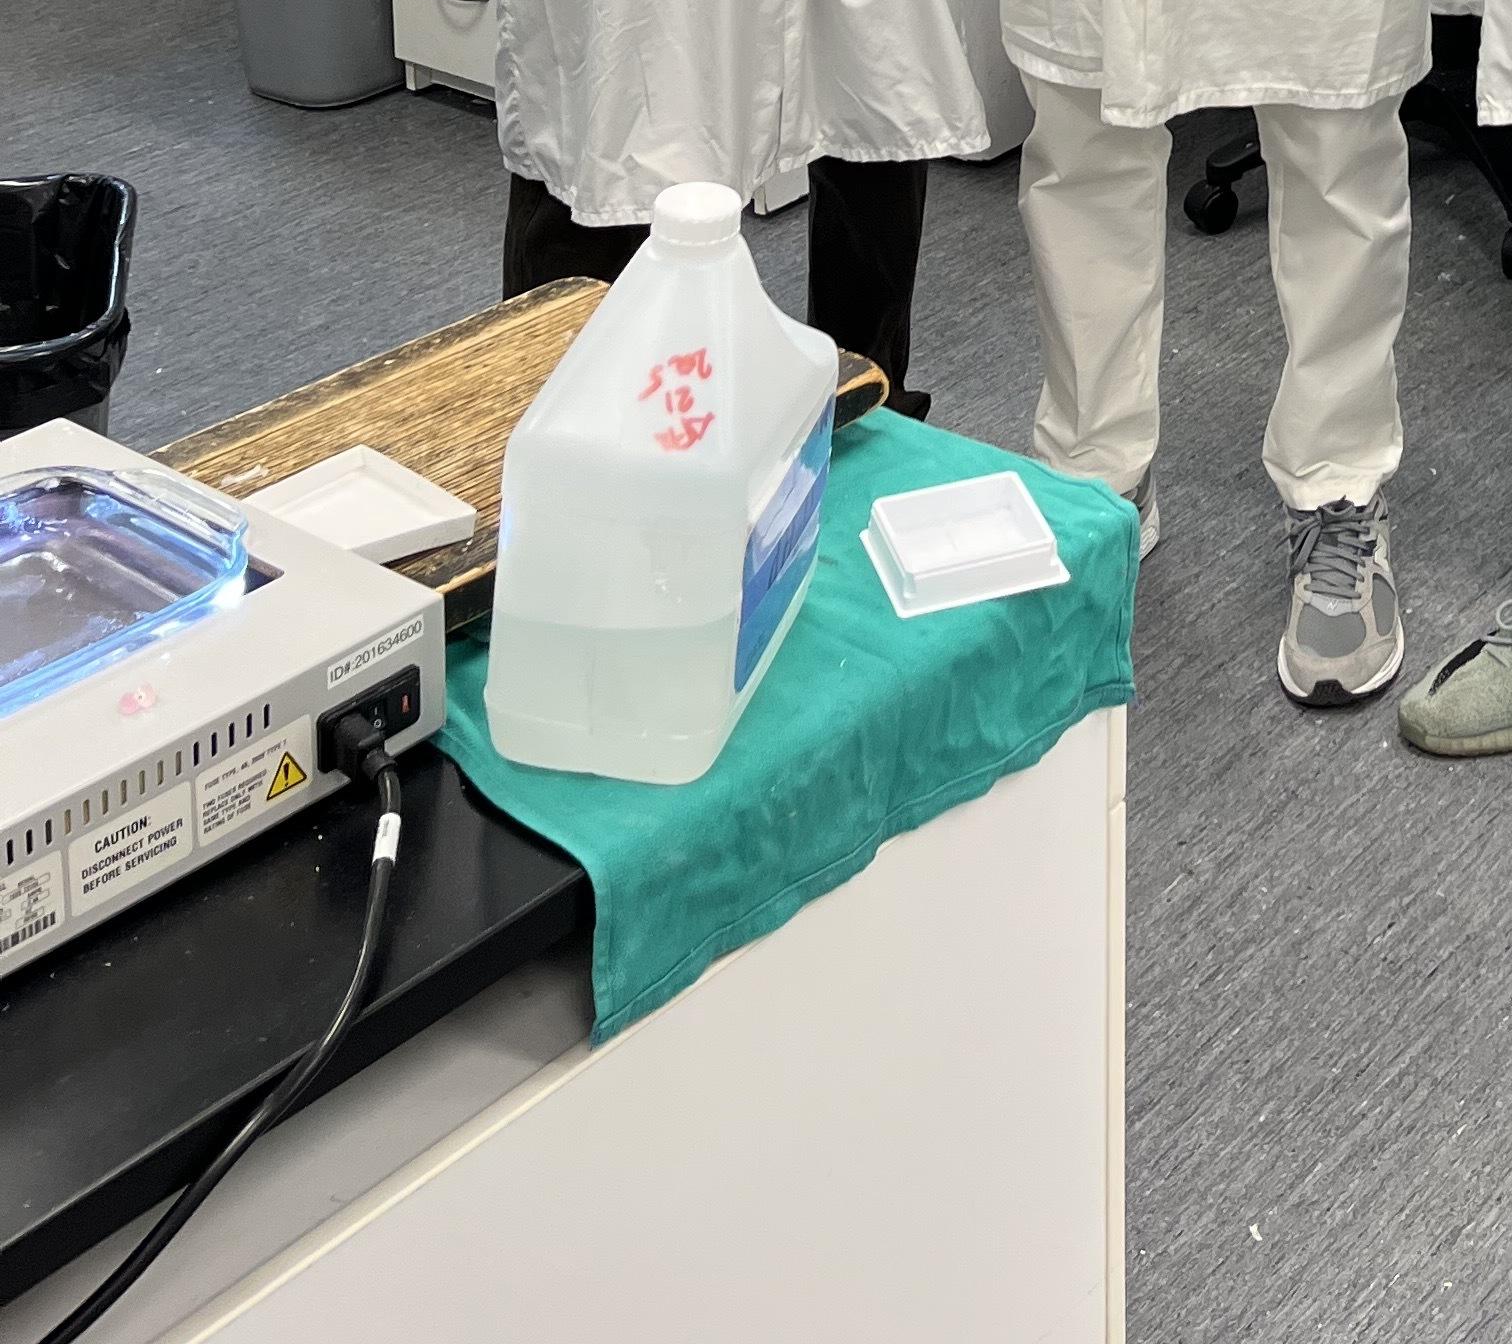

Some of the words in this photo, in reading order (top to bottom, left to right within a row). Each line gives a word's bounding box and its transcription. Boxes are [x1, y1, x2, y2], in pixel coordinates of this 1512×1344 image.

[81, 838, 144, 880] DISCONNECT
[147, 818, 183, 845] POWER
[94, 815, 152, 854] CAUTION:
[83, 866, 121, 894] BEFORE
[124, 836, 177, 872] SERVICING
